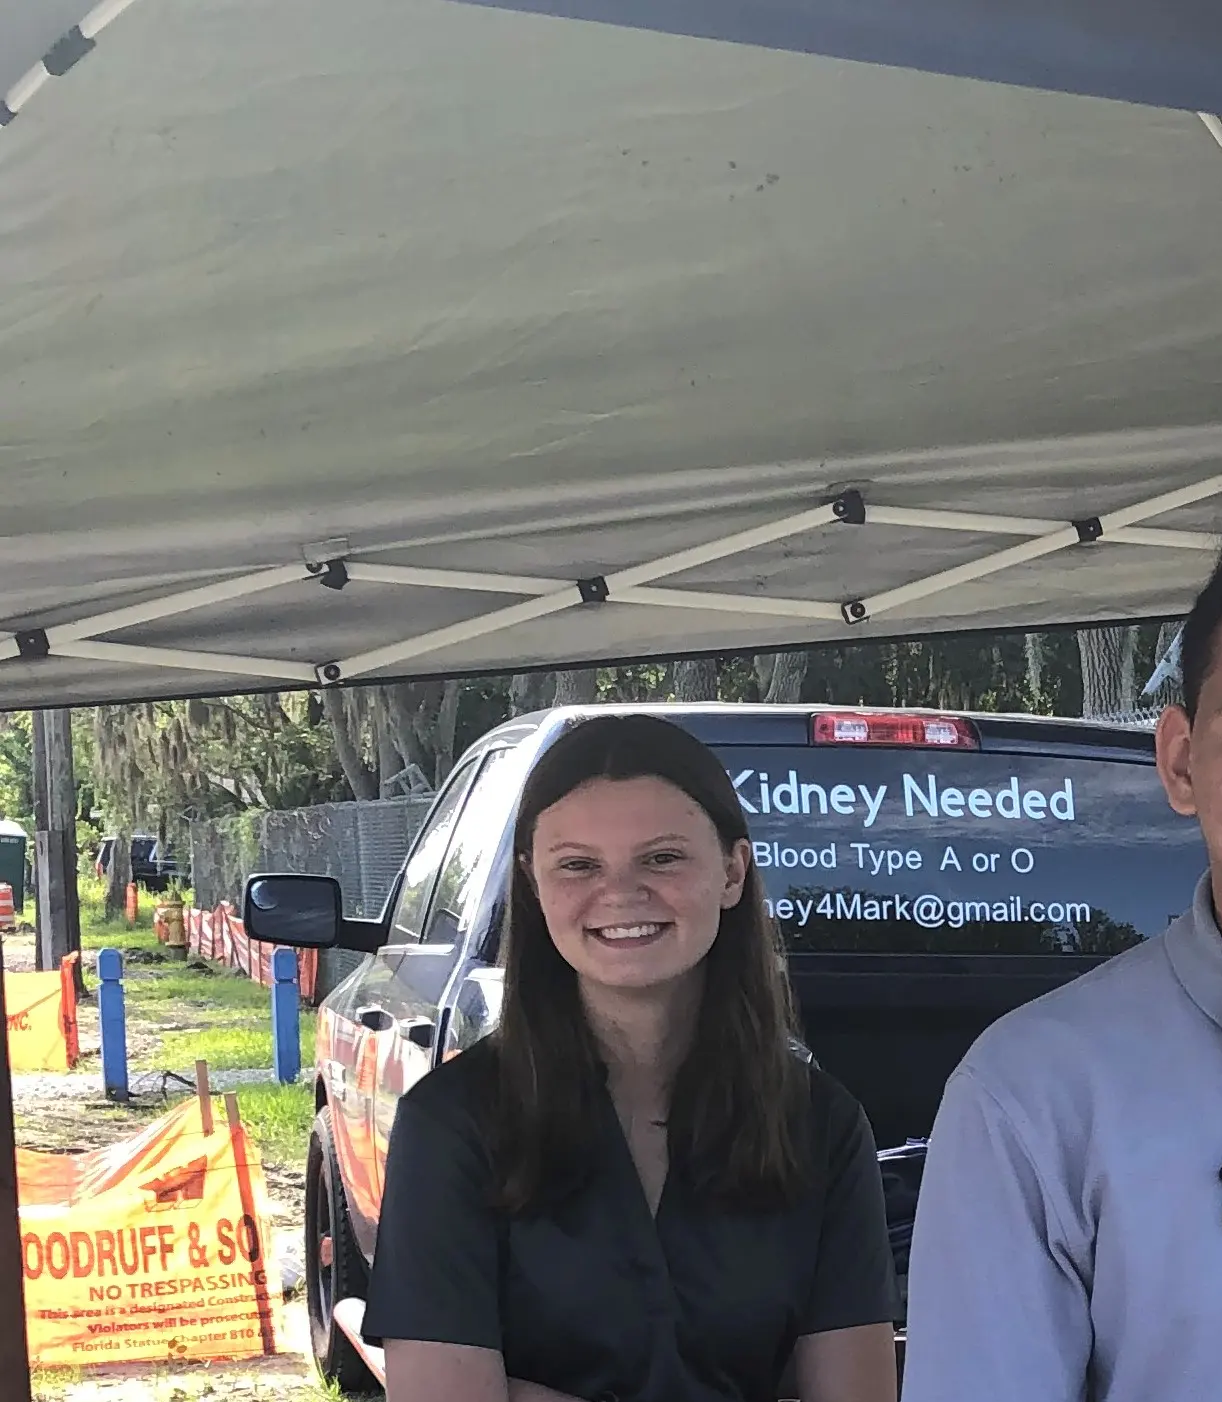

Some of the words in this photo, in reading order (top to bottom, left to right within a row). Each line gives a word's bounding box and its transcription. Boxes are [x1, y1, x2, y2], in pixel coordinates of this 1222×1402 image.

[726, 769, 888, 828] Kidney
[902, 773, 1075, 821] Needed
[752, 841, 837, 868] Blood
[850, 843, 922, 876] Type
[939, 846, 962, 872] A
[972, 852, 1000, 873] or
[1011, 848, 1034, 873] O
[764, 893, 1091, 928] ney4Mark@gmail.com
[22, 1225, 174, 1280] OODRUFF
[188, 1221, 209, 1268] &
[89, 1284, 122, 1301] NO
[126, 1269, 267, 1300] TRESPASSING
[180, 1315, 198, 1327] be
[72, 1339, 121, 1352] Florida
